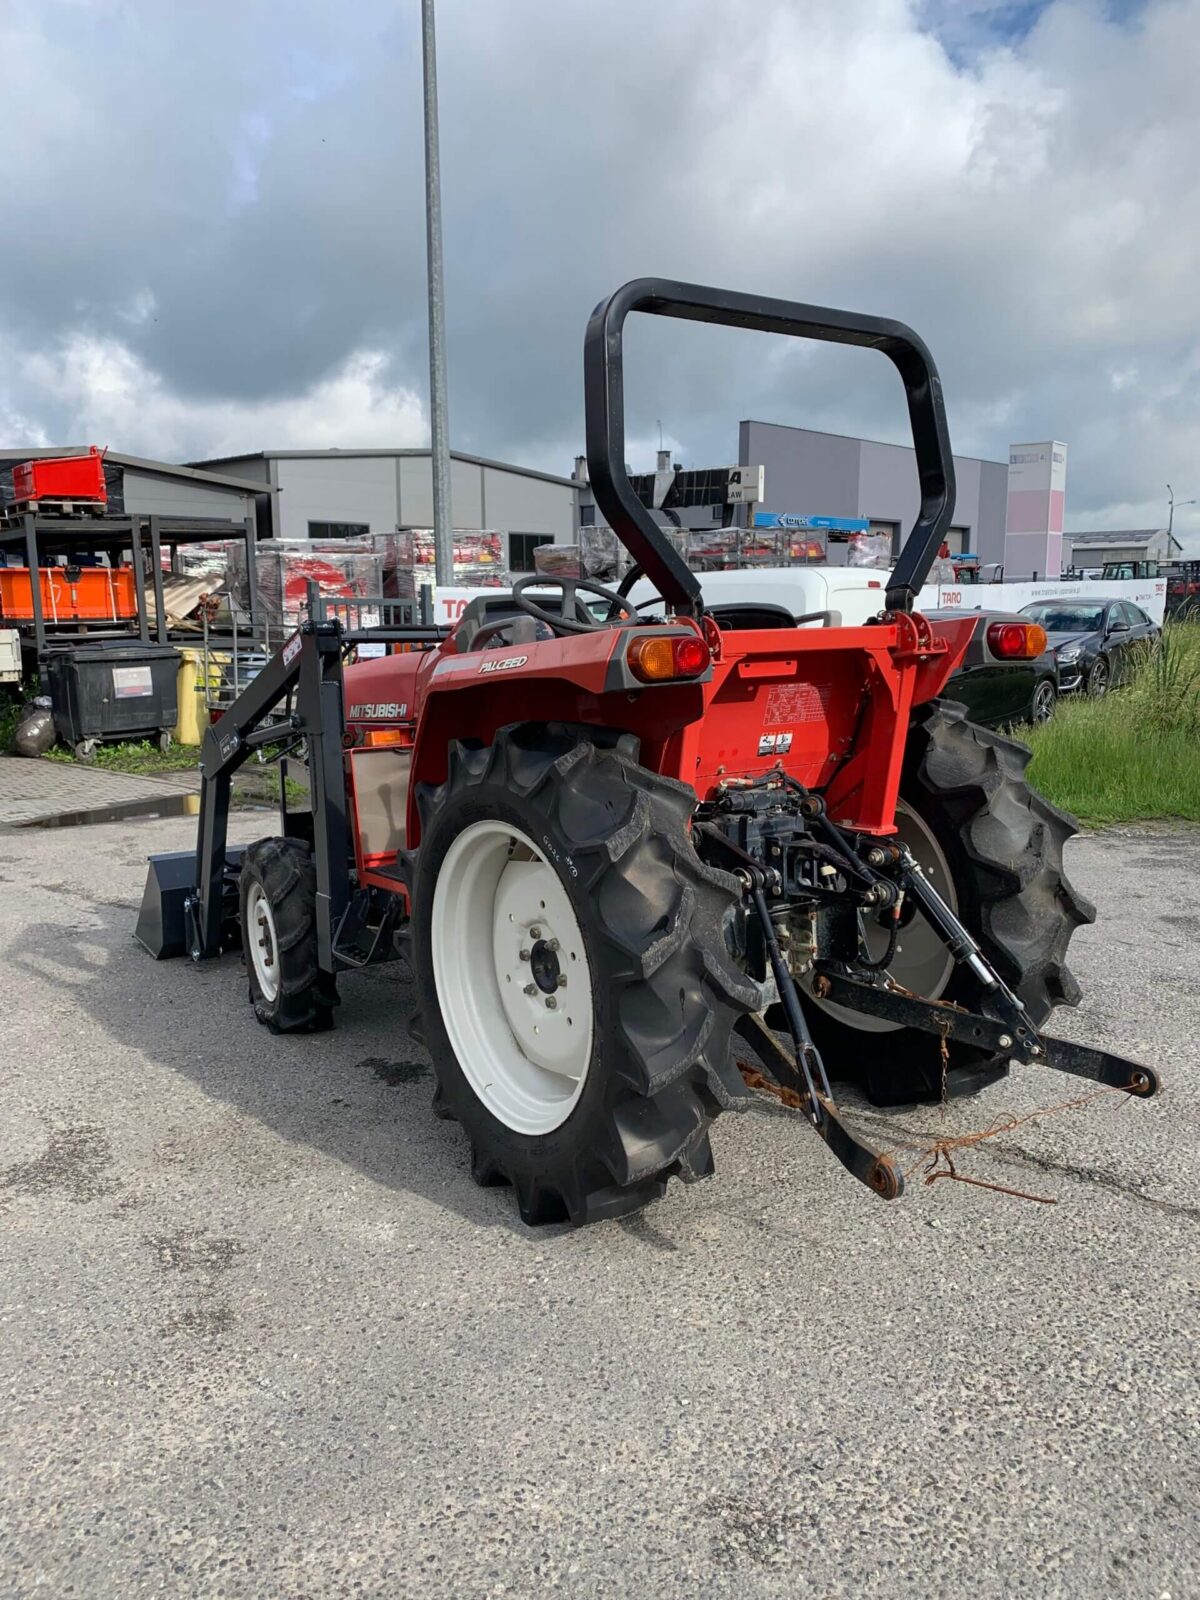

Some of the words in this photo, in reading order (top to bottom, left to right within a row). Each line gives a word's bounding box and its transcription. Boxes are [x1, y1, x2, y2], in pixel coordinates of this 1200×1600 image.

[942, 592, 961, 604] TARO
[362, 615, 379, 625] 23A
[479, 656, 528, 674] PALCEED
[349, 703, 407, 718] MITSUBISHI
